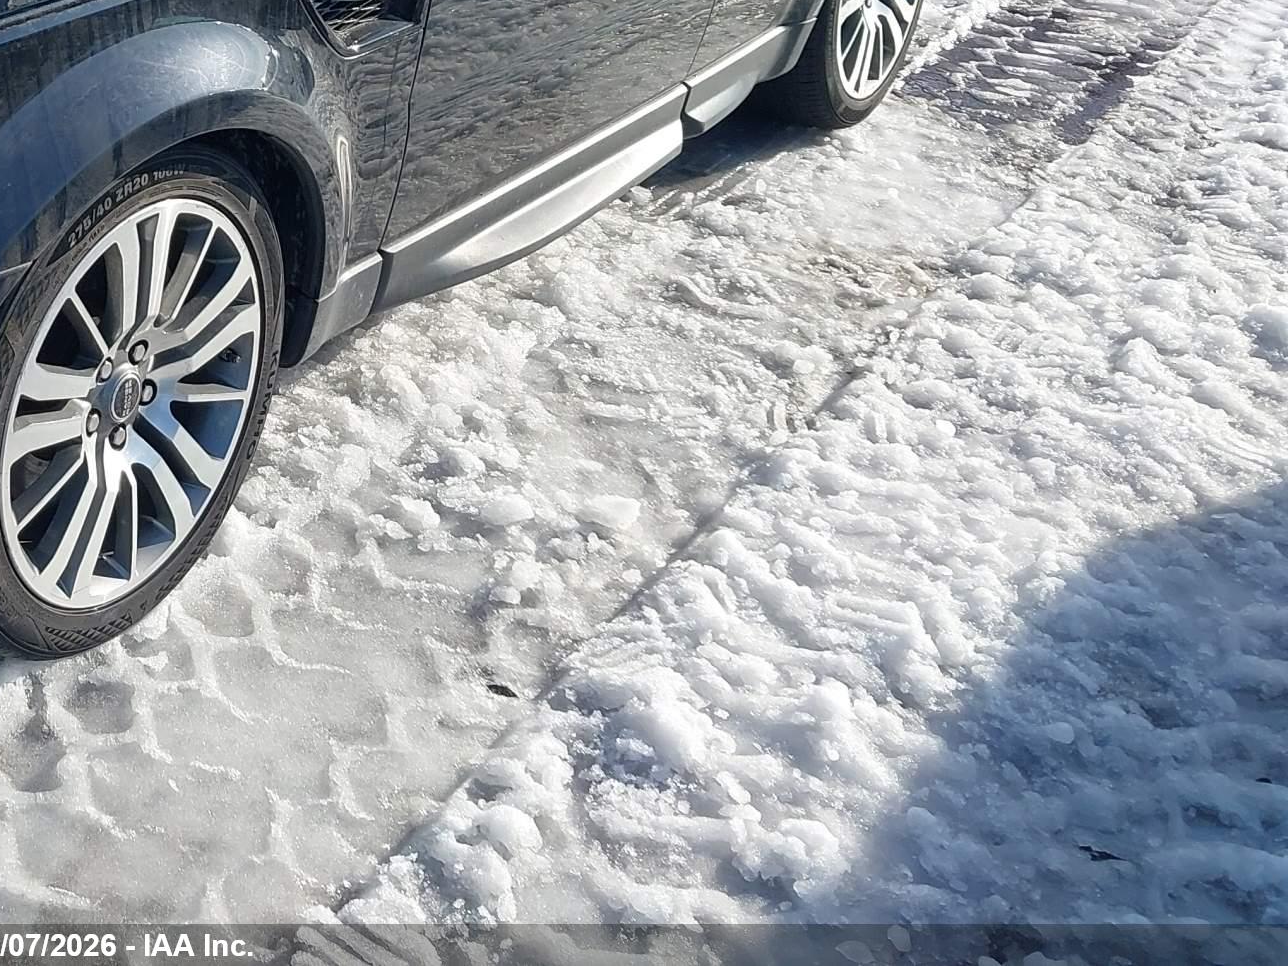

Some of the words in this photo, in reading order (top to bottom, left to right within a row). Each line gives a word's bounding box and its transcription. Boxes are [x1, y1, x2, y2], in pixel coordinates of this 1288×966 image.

[67, 197, 112, 248] 275/40
[115, 173, 149, 203] ZR20
[245, 350, 279, 460] KUMHO
